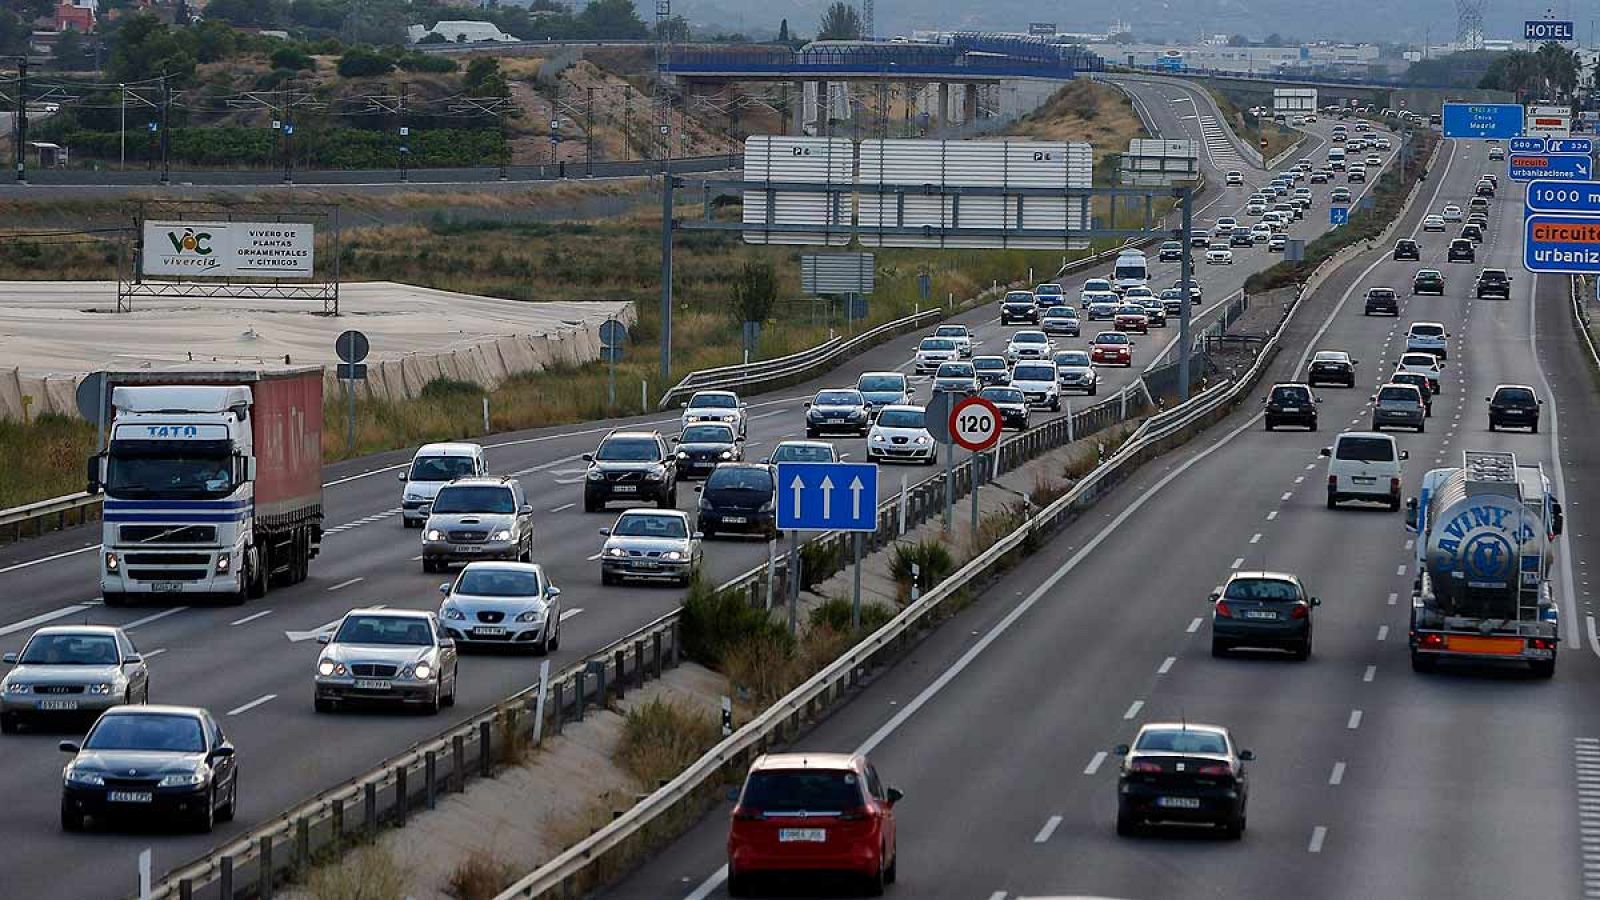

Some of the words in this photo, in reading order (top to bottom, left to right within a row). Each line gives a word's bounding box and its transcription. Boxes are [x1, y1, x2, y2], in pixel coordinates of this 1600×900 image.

[1526, 24, 1571, 37] HOTEL
[1512, 168, 1574, 178] urbanizaciones
[1536, 190, 1580, 202] 1000
[238, 249, 308, 257] ORNAMENTALES
[960, 415, 991, 433] 120
